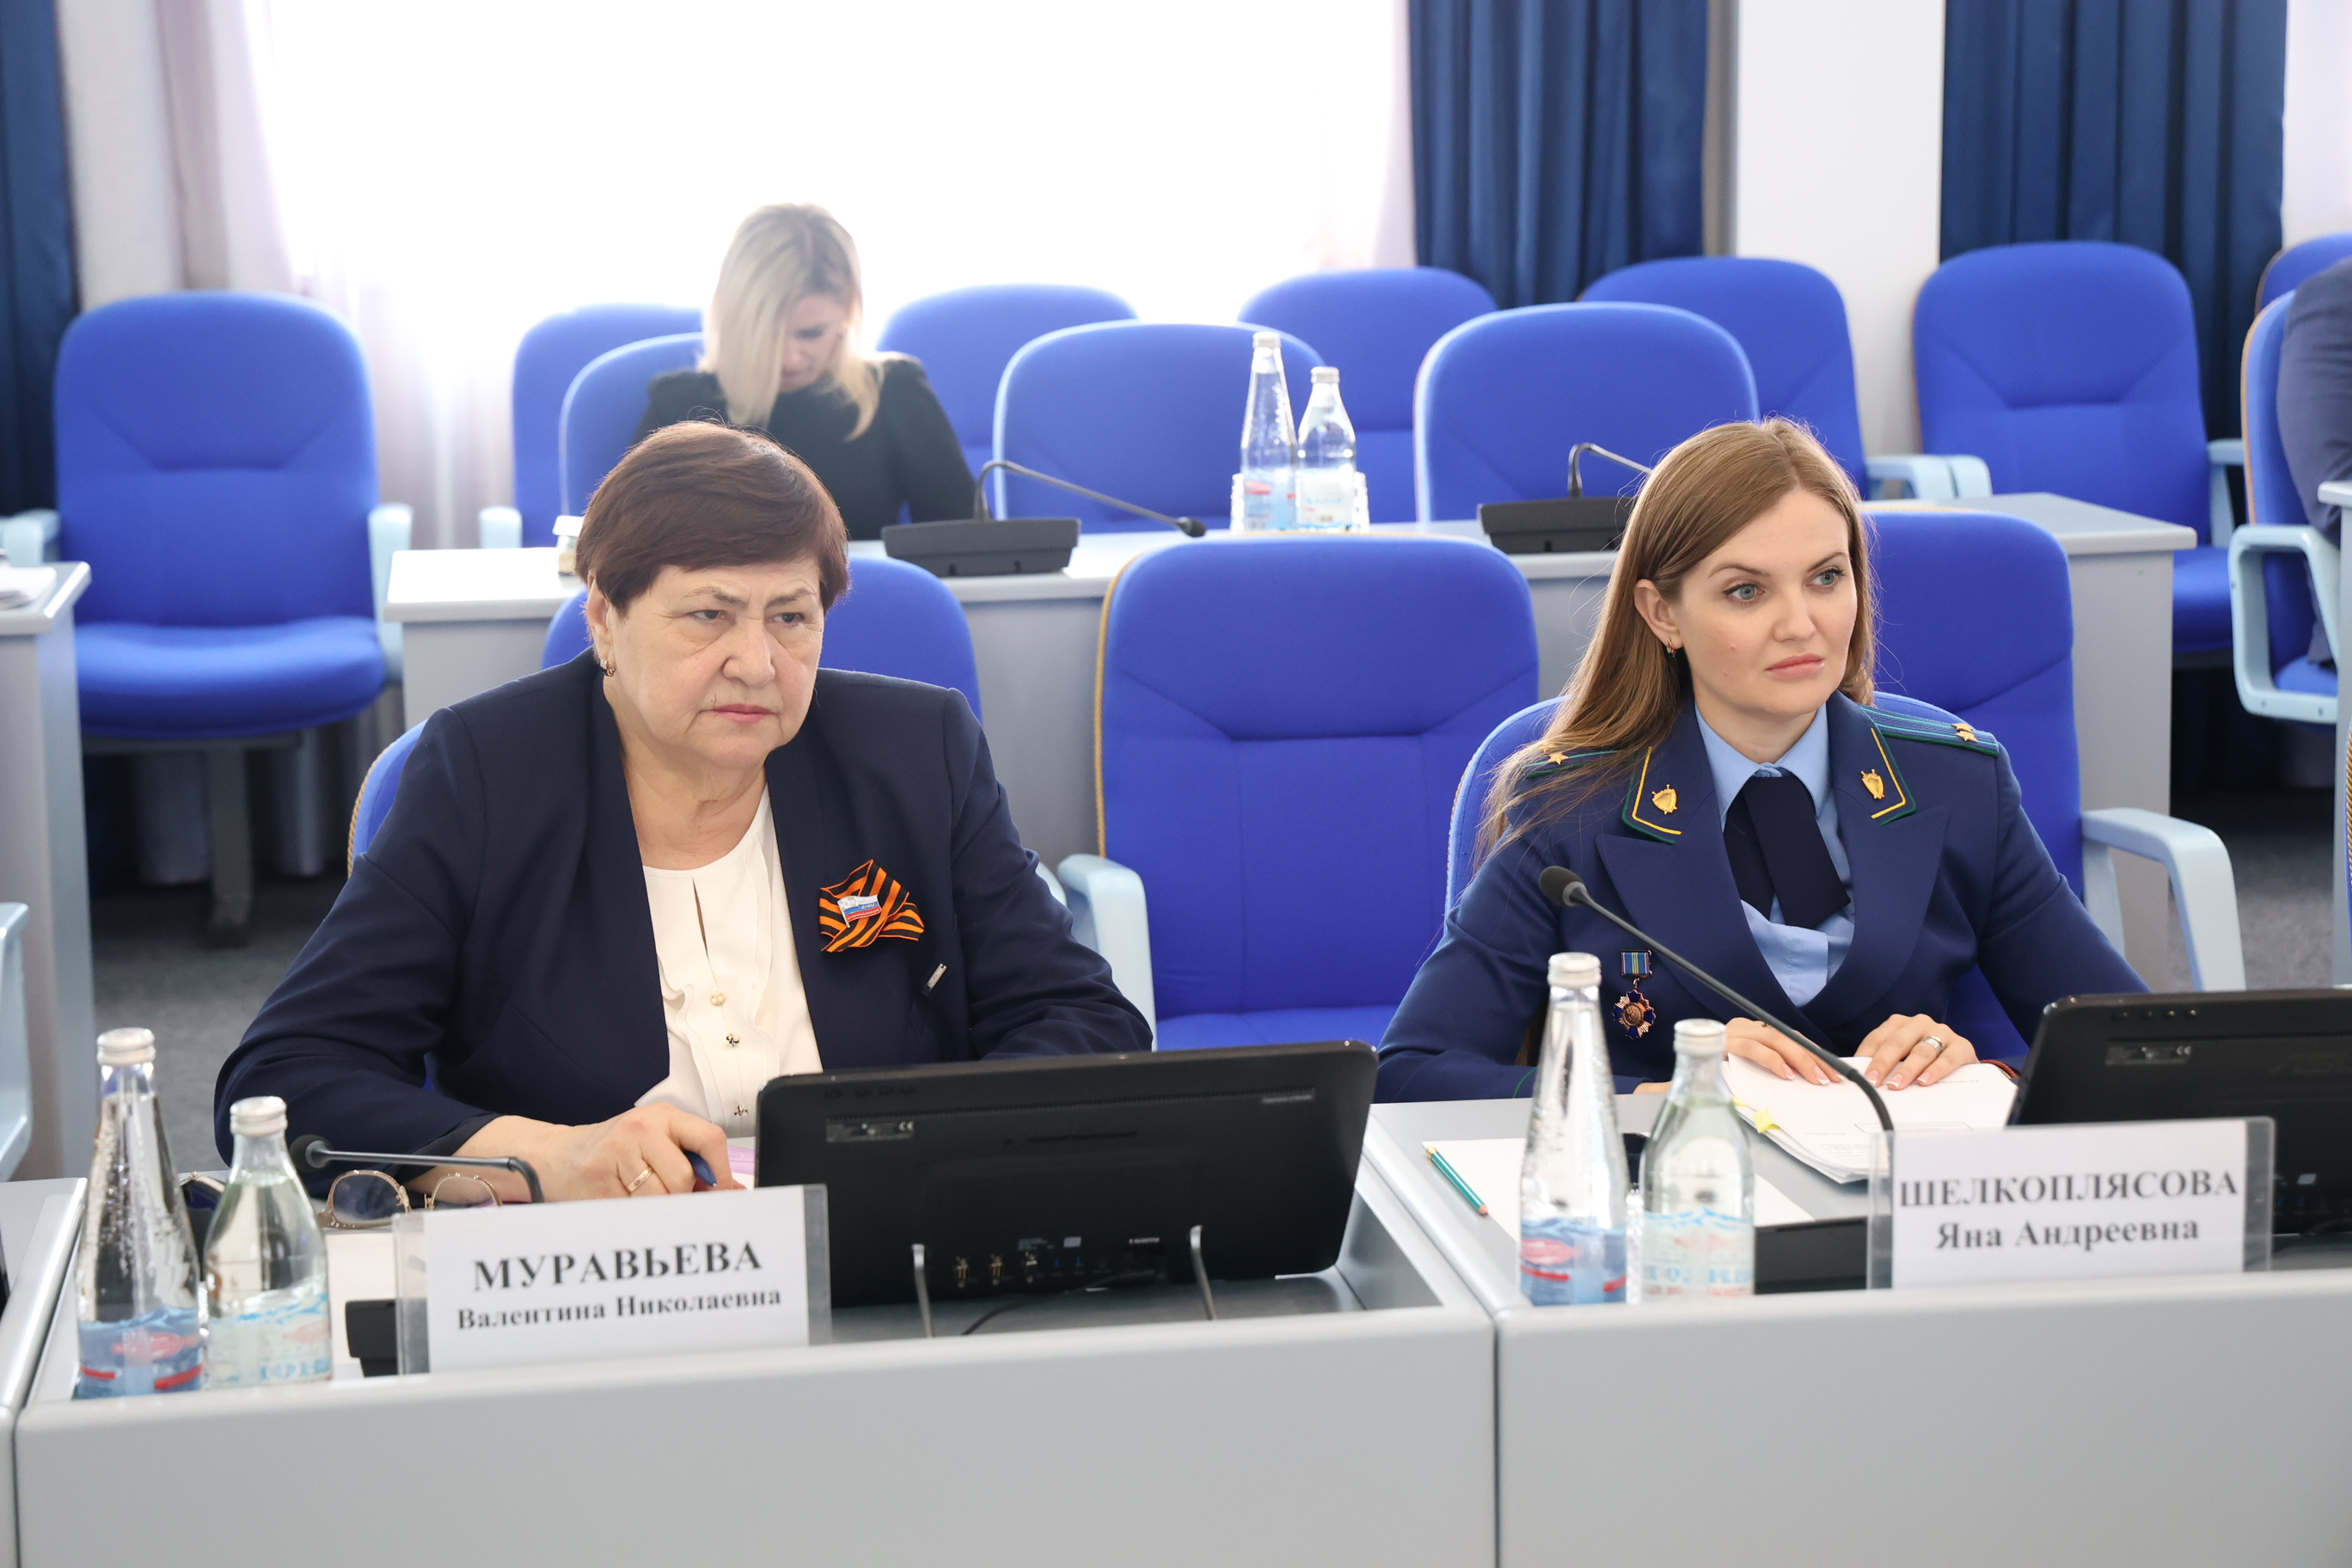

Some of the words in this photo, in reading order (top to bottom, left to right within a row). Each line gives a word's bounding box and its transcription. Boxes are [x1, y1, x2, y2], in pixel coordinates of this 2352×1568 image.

[1900, 1170, 2239, 1207] ШЕЛКОПЛЯСОВА
[1935, 1222, 2002, 1250] Яна
[2014, 1220, 2199, 1252] Андреевна
[473, 1240, 763, 1291] МУРАВЬЕВА
[457, 1302, 605, 1331] Валентина
[616, 1290, 781, 1318] Николаевна
